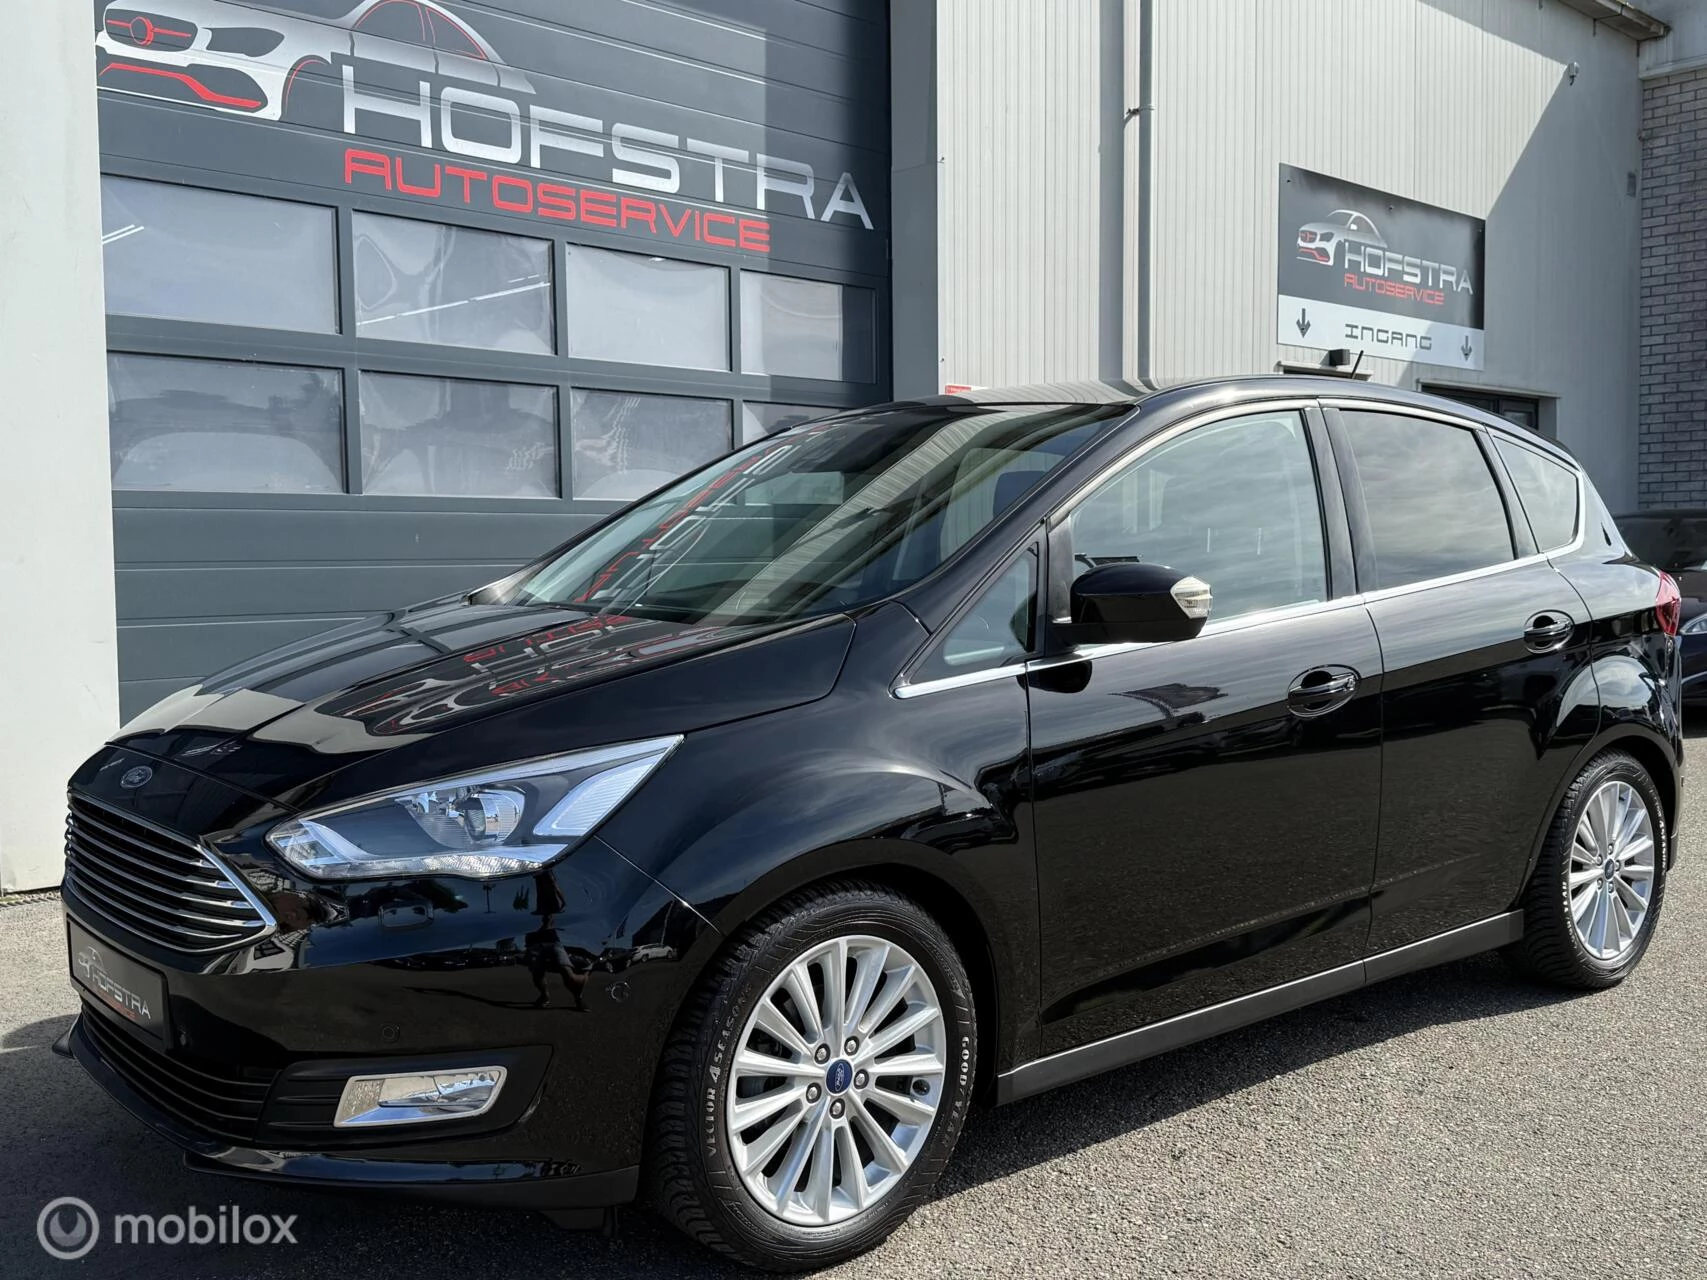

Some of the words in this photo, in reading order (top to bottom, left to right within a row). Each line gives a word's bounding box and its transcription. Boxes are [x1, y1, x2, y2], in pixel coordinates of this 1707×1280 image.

[342, 64, 875, 231] HOFSTRA
[344, 148, 771, 254] AUTOSERVICE
[1343, 272, 1445, 305] AUTOSERVICE
[1344, 241, 1474, 296] HOFSTRA
[1344, 322, 1433, 351] INGANG
[92, 966, 152, 1020] HOFSTRA
[705, 1086, 717, 1158] VECTOR
